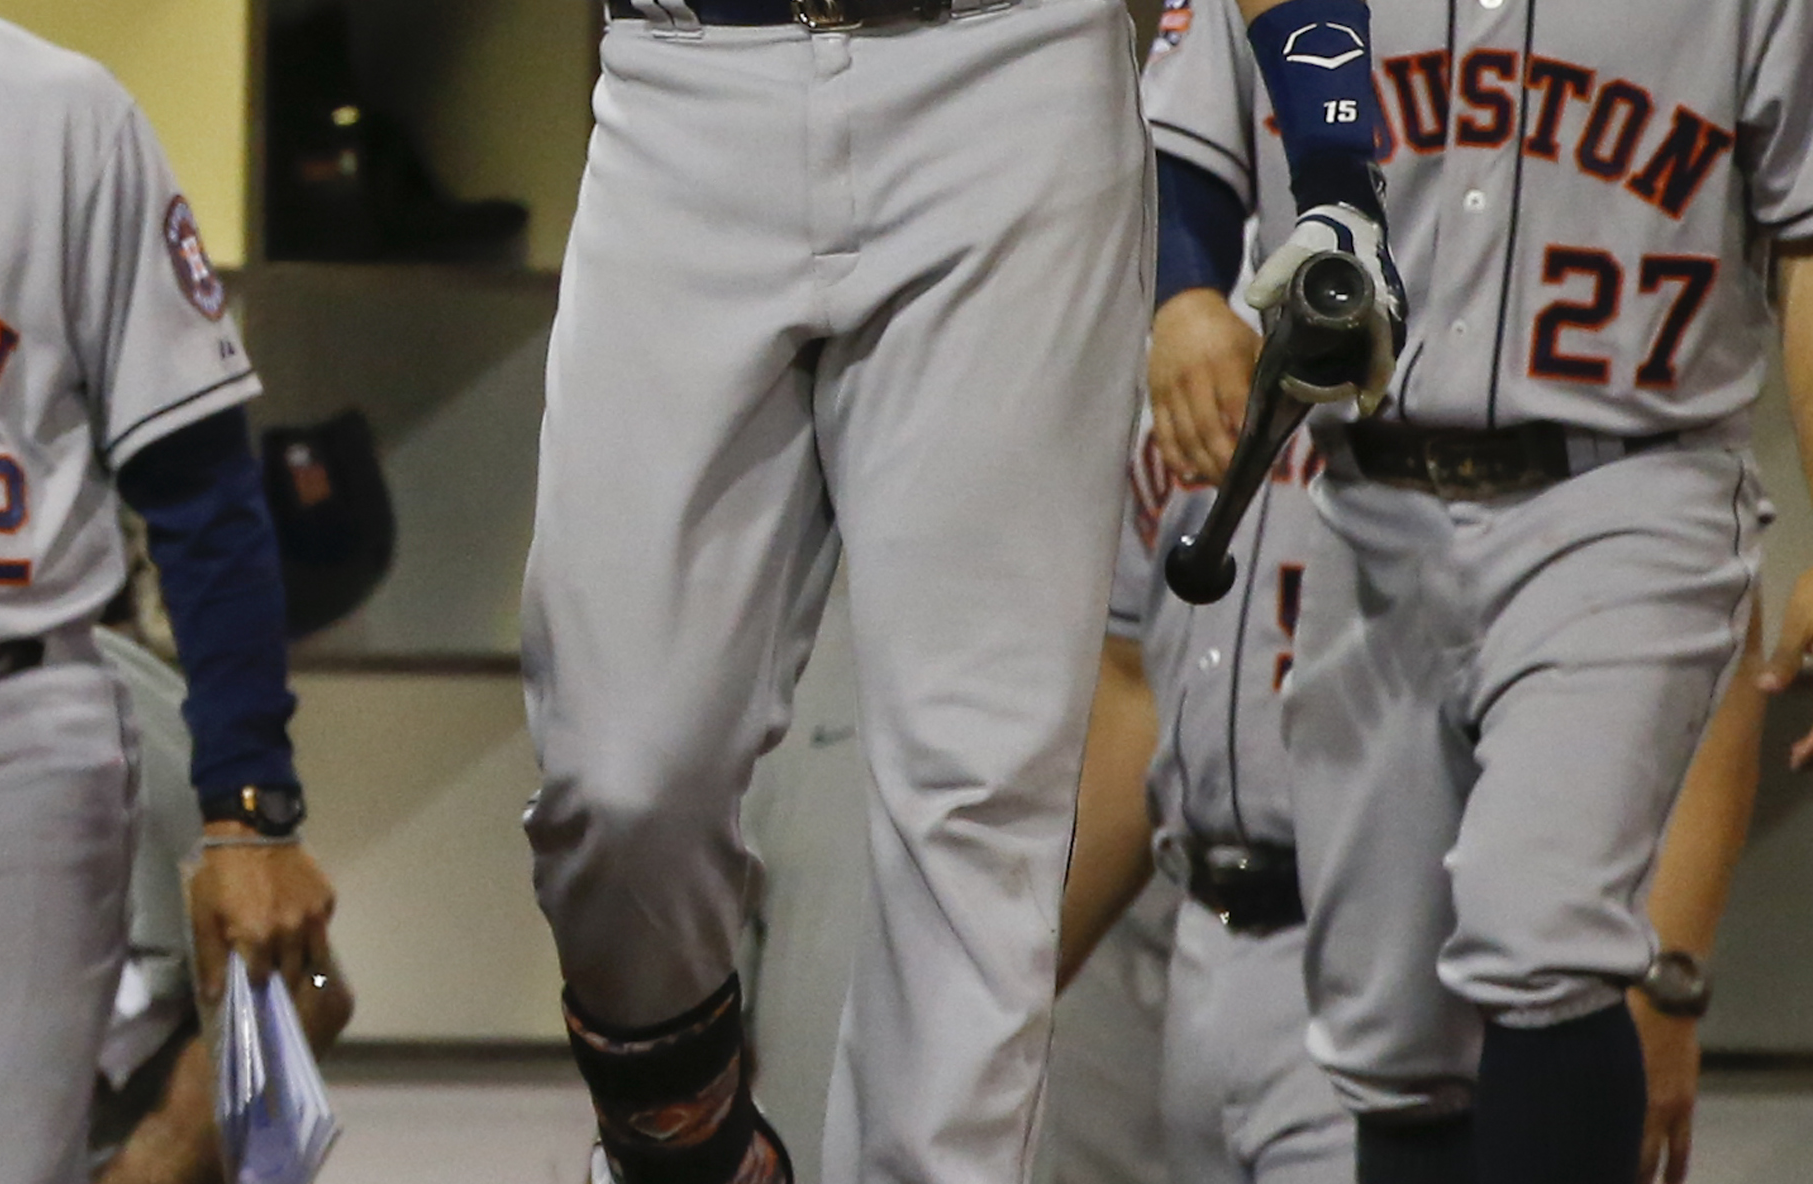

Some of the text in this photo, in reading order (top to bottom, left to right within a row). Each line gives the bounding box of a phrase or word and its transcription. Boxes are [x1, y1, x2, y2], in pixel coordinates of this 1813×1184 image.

[1324, 100, 1357, 123] 15
[1368, 47, 1734, 220] USTON
[1527, 243, 1720, 390] 27
